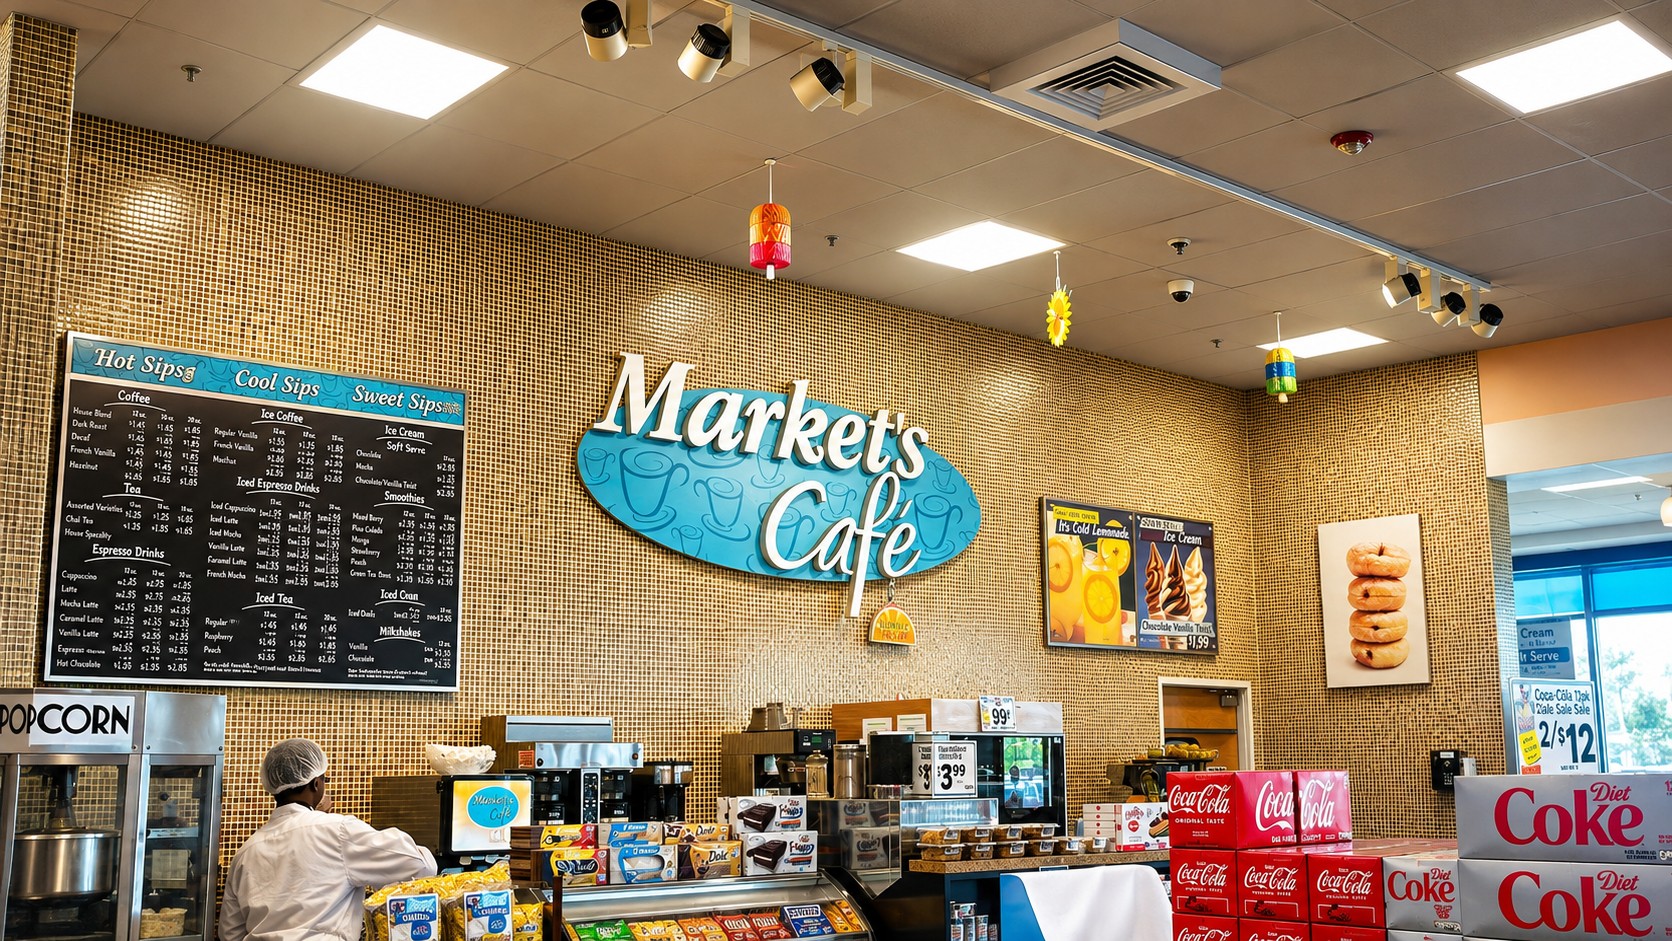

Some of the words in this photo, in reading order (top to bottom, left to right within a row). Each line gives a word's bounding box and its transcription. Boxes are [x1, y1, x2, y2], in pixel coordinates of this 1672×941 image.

[94, 348, 136, 371] Hot
[140, 355, 184, 382] Sips
[234, 368, 278, 391] Cool
[281, 375, 320, 401] Sips
[118, 390, 150, 404] Coffee
[352, 384, 405, 408] Sweet
[408, 393, 443, 417] Sips
[261, 408, 274, 420] Ice
[276, 410, 304, 424] Coffee
[592, 351, 930, 481] Market's
[384, 425, 398, 436] Ice
[399, 427, 424, 439] Cream
[386, 441, 403, 452] Soft
[124, 482, 141, 494] Tea
[236, 476, 255, 488] Iced
[258, 478, 292, 491] Espresso
[295, 482, 320, 494] Drinks
[384, 491, 425, 504] Smoothies
[1058, 519, 1070, 532] It's
[1072, 522, 1090, 535] Cold
[761, 471, 922, 618] Café
[1164, 530, 1176, 542] Ice
[1178, 531, 1202, 546] Cream
[92, 544, 132, 557] Espresso
[136, 546, 165, 559] Drinks
[256, 592, 275, 603] Iced
[277, 593, 294, 604] Tea
[380, 626, 421, 638] Milkshakes
[1520, 628, 1554, 638] Cream
[1530, 650, 1560, 662] Serve
[0, 703, 130, 735] POPCORN
[1168, 784, 1231, 814] Coca-Cola
[1590, 782, 1632, 802] Diet
[1494, 788, 1645, 847] Coke
[1176, 863, 1228, 887] Coca-Cola
[1244, 866, 1298, 890] Coca-Cola
[1317, 869, 1374, 895] Coca-Cola
[1430, 868, 1452, 880] Diet
[1596, 870, 1640, 892] Diet
[1388, 870, 1456, 903] Coke
[1498, 870, 1654, 938] Coke
